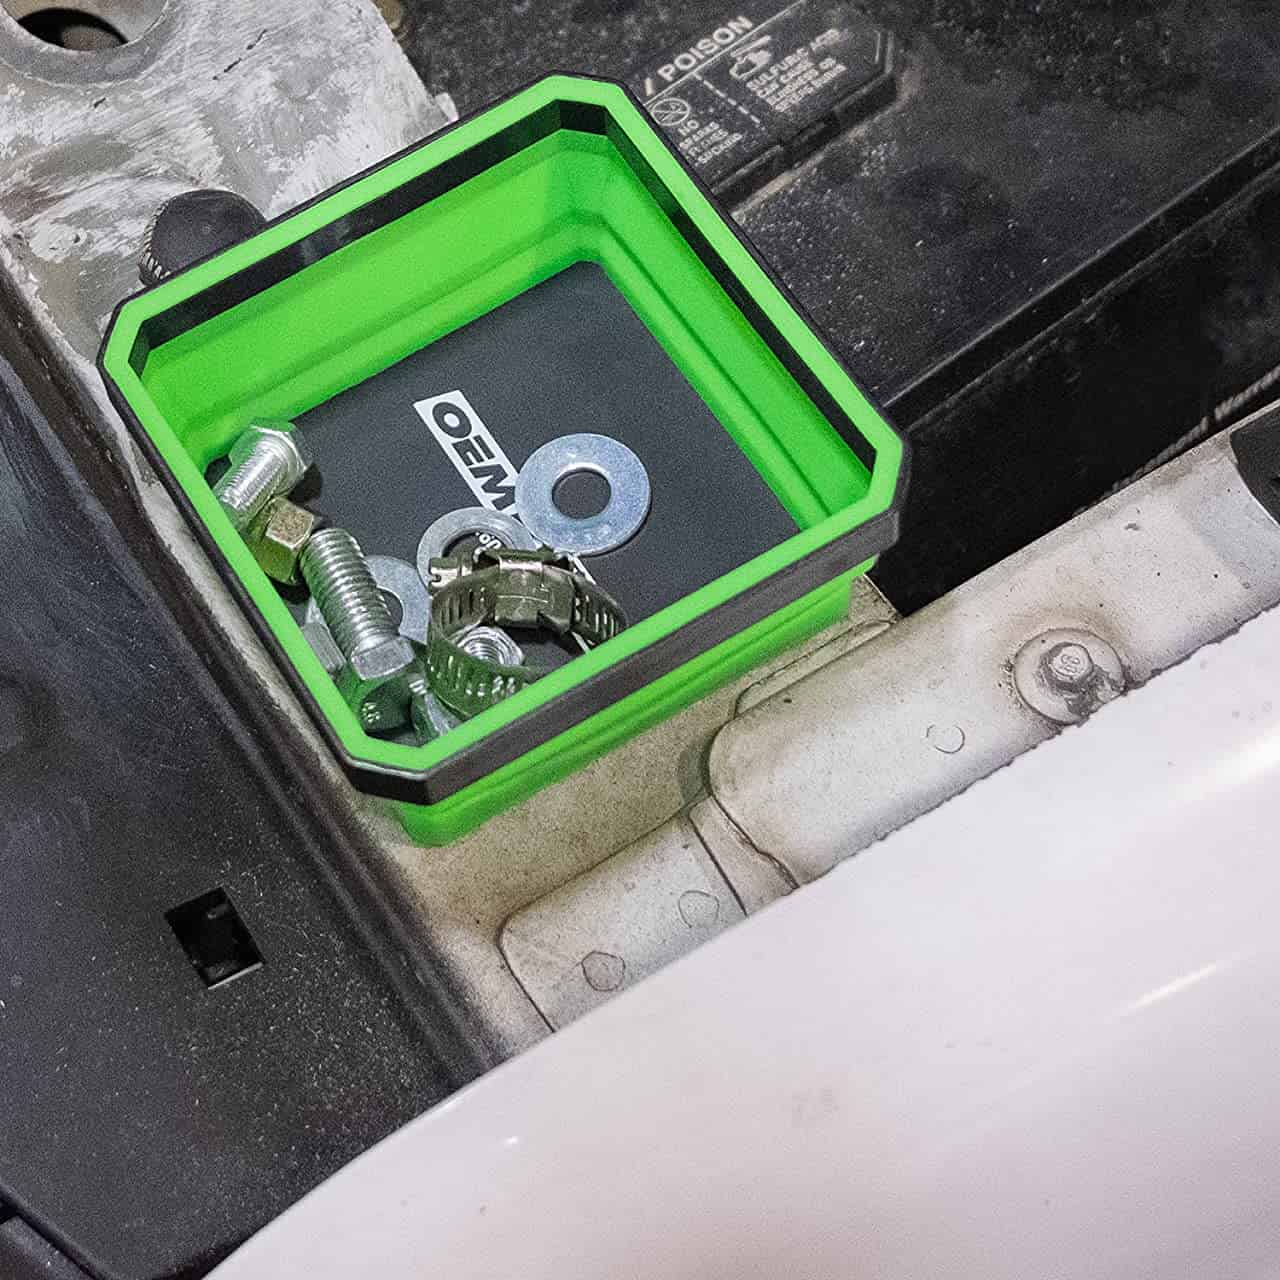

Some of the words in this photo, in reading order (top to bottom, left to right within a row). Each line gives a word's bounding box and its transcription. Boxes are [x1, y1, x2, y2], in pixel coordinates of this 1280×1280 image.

[656, 15, 753, 82] POISON
[746, 46, 808, 92] SULFURIC
[678, 117, 700, 136] NO
[432, 402, 517, 511] OEM
